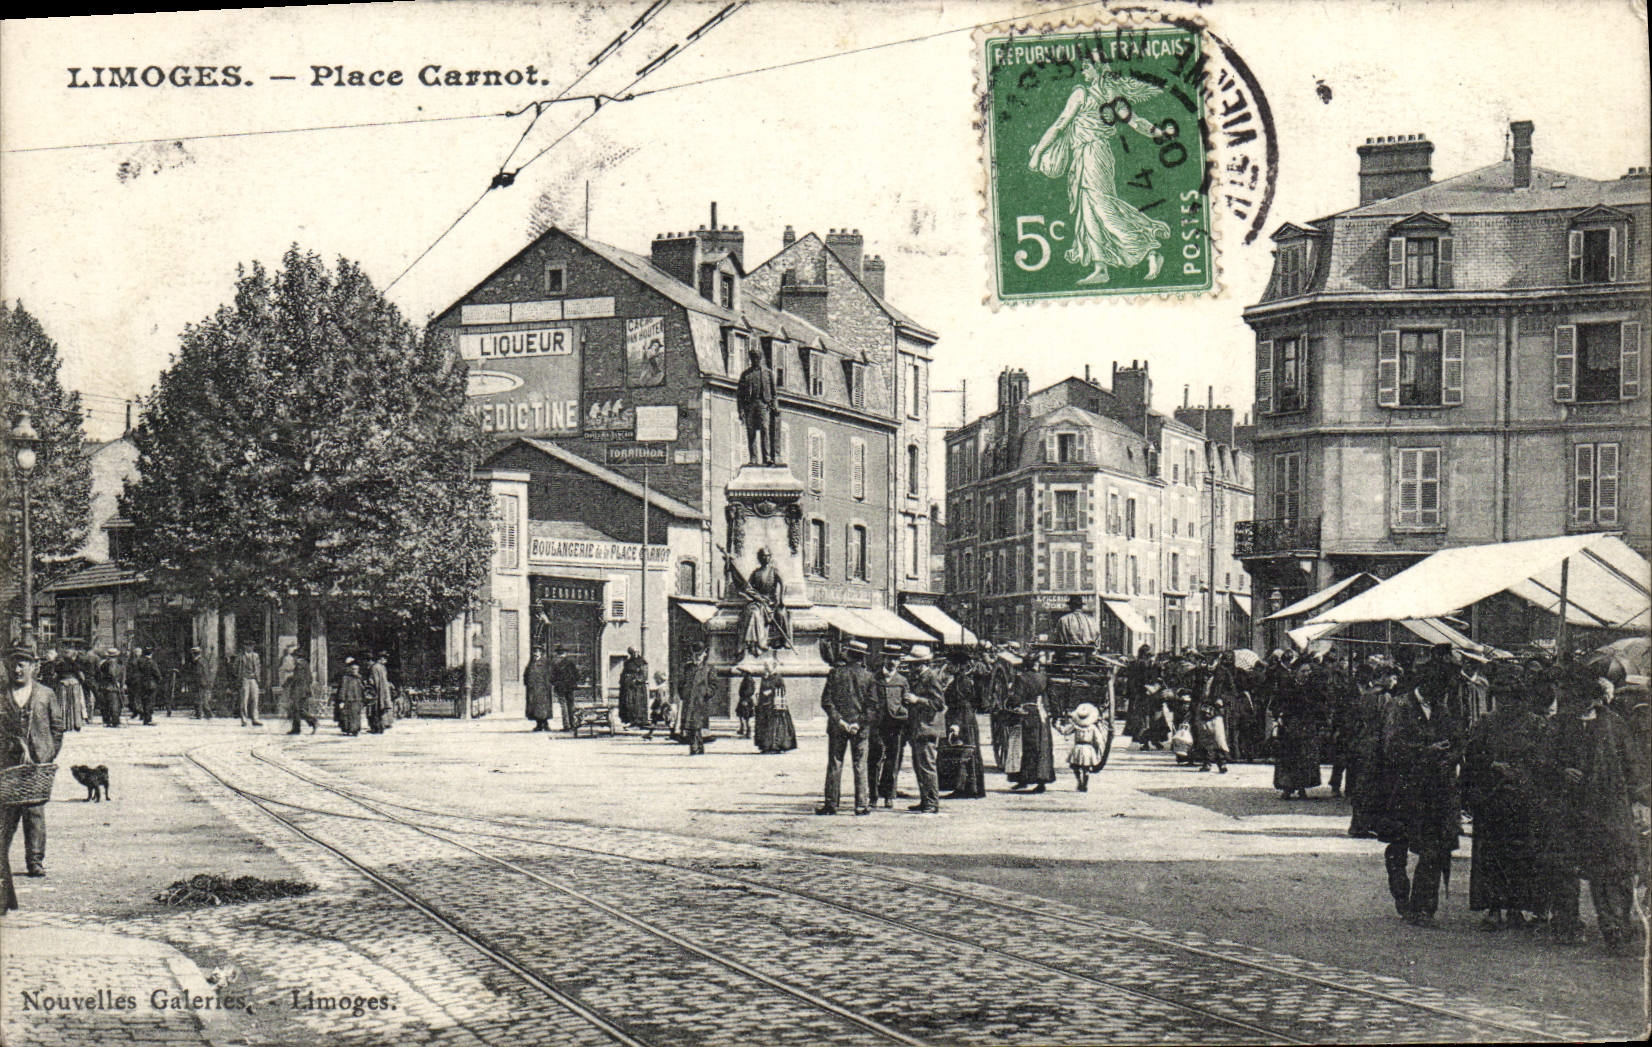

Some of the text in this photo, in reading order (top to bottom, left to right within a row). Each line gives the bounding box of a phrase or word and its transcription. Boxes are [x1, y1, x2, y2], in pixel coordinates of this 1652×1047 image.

[1110, 37, 1192, 60] FRANÇAIS
[1180, 189, 1202, 275] POSTES
[480, 331, 565, 357] LIQUEUR
[532, 539, 594, 558] BOULANGERIE
[610, 544, 637, 560] PLACE
